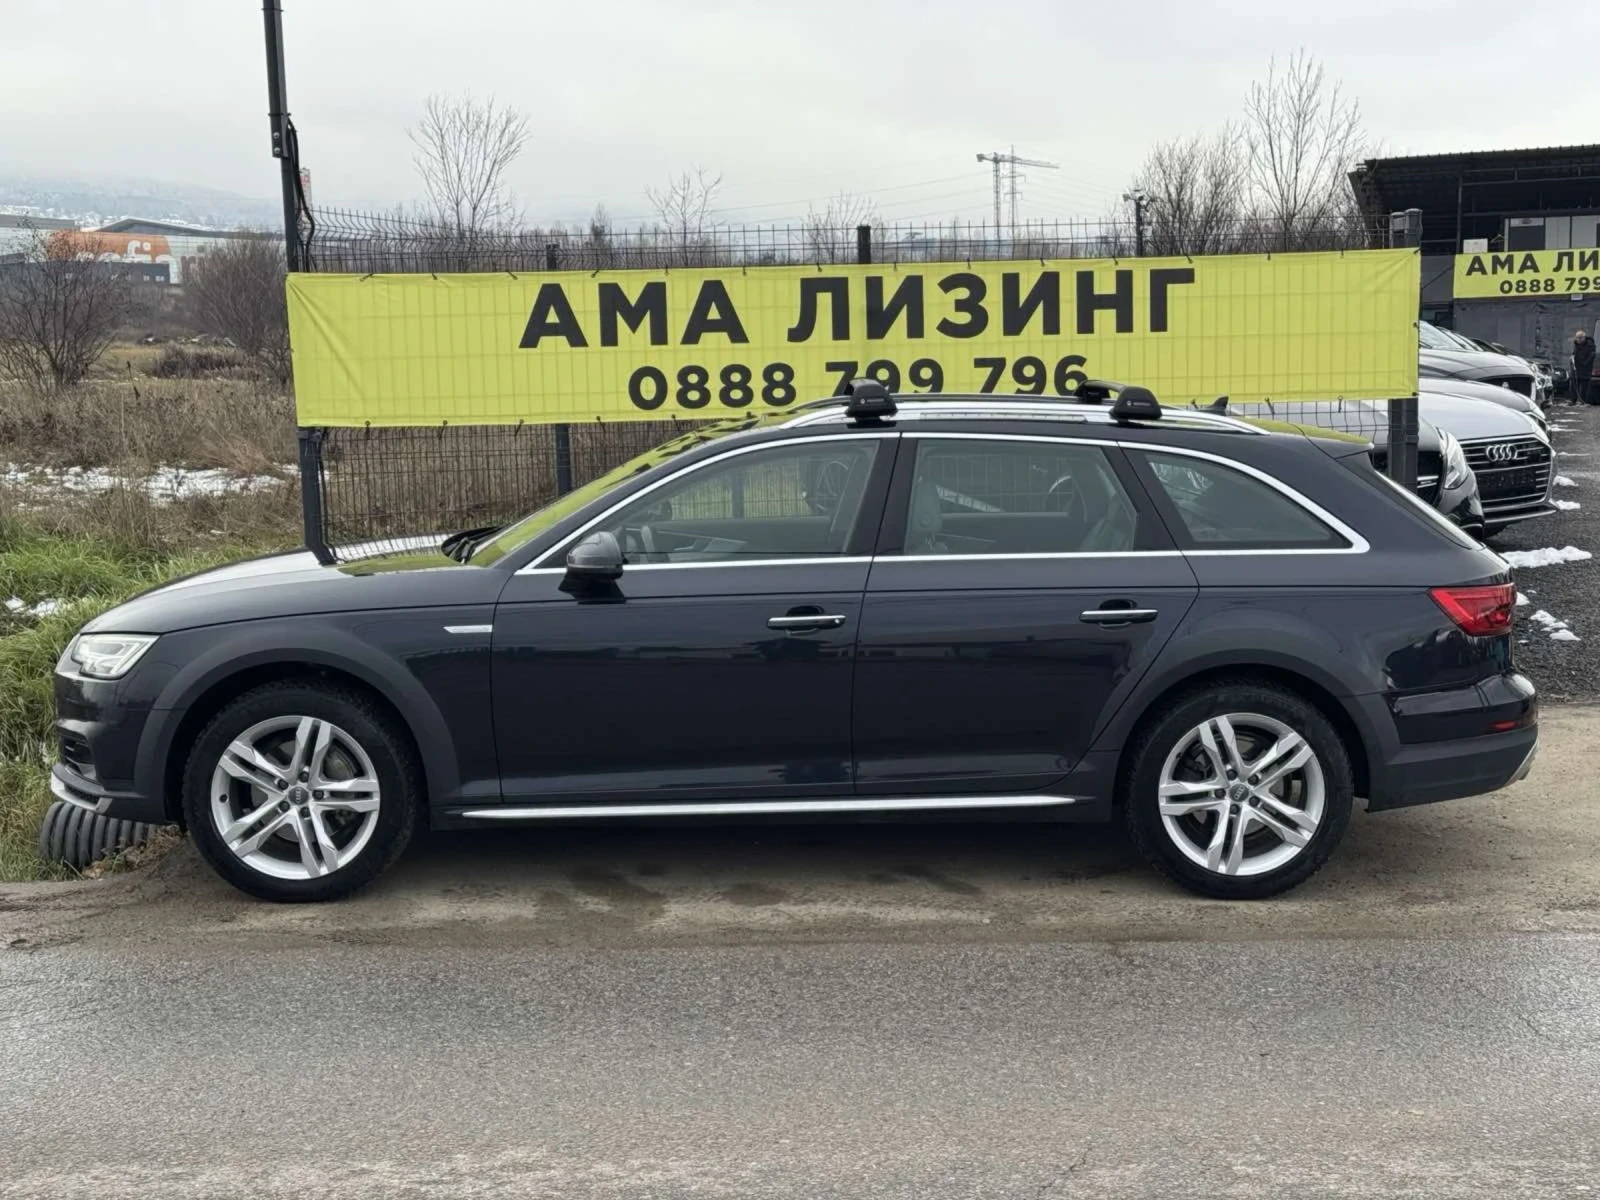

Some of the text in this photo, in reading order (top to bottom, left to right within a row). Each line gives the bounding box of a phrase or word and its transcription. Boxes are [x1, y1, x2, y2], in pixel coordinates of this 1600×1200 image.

[1465, 253, 1541, 276] АМА
[1499, 277, 1555, 294] 0888
[518, 267, 1196, 349] АМА ЛИЗИНГ
[628, 362, 797, 411] 0888
